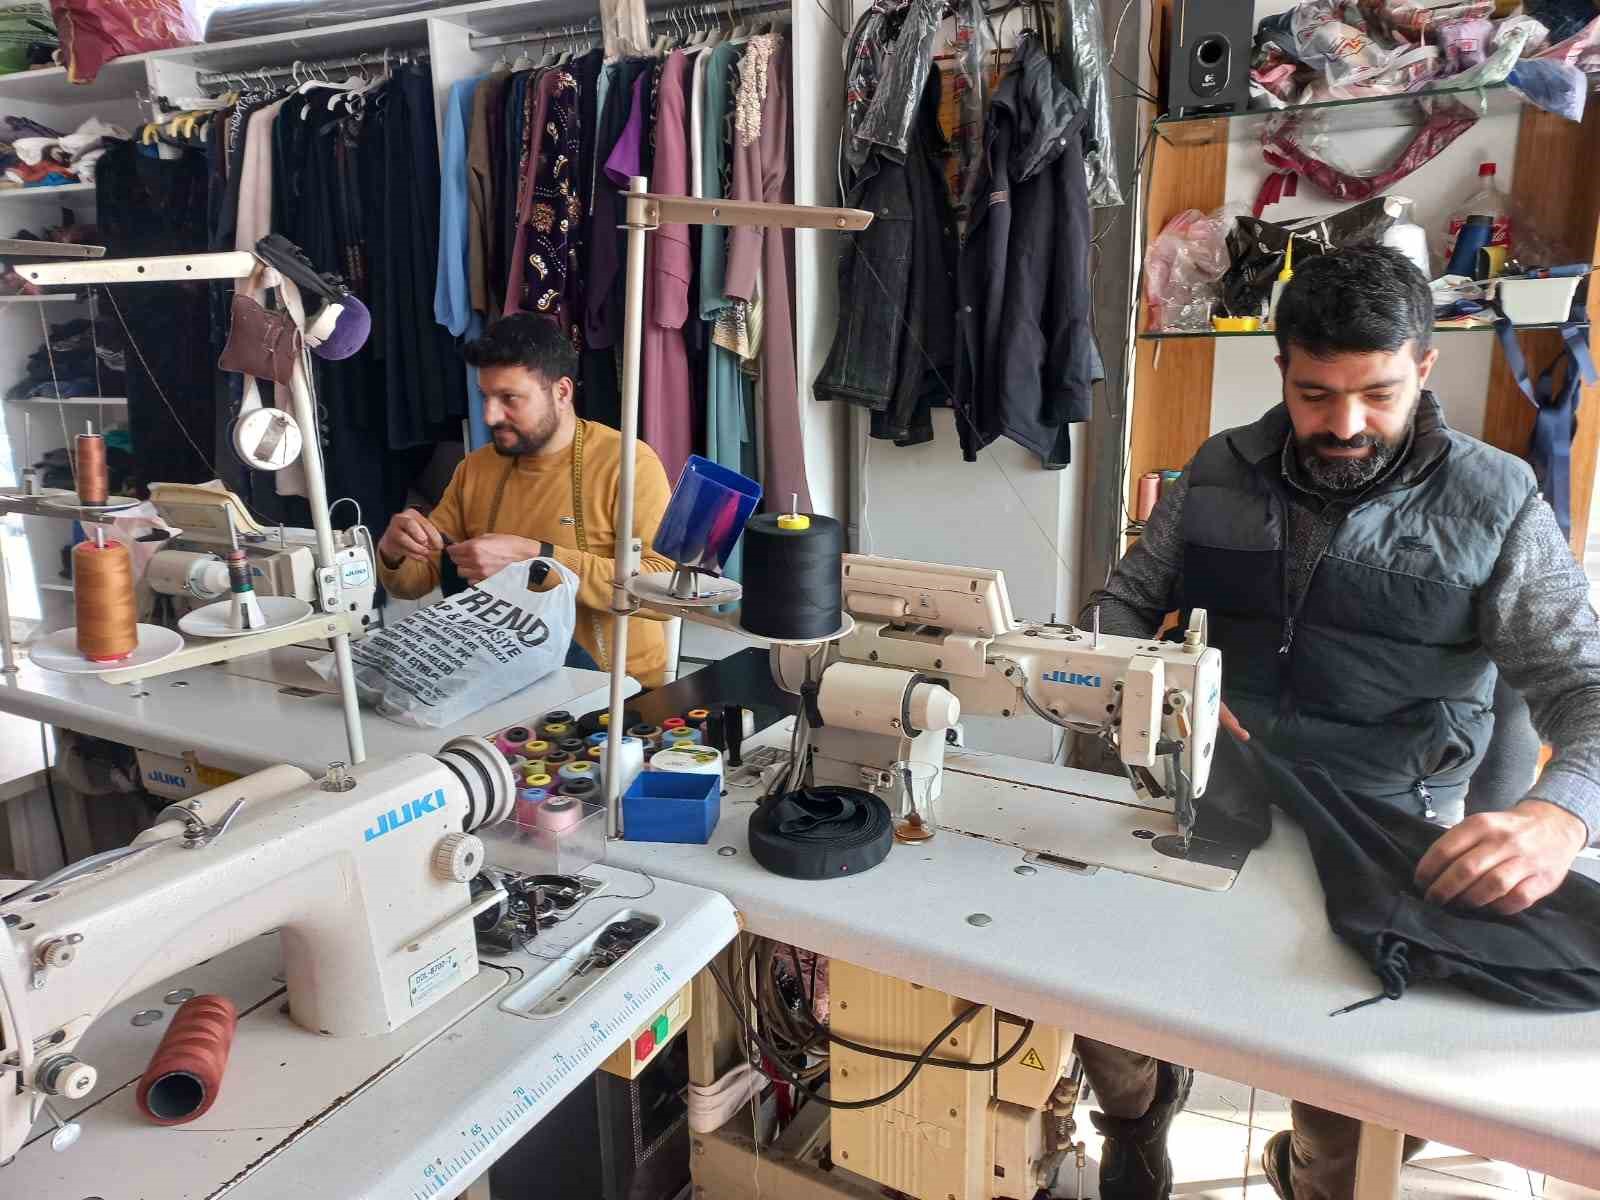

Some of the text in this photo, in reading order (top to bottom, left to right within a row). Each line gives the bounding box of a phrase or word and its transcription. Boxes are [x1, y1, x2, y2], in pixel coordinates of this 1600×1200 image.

[445, 612, 461, 620] &
[1043, 671, 1102, 688] JUKI
[148, 770, 185, 787] JUKI
[364, 788, 448, 842] JUKI
[470, 1124, 482, 1136] 65
[512, 1086, 525, 1097] 70
